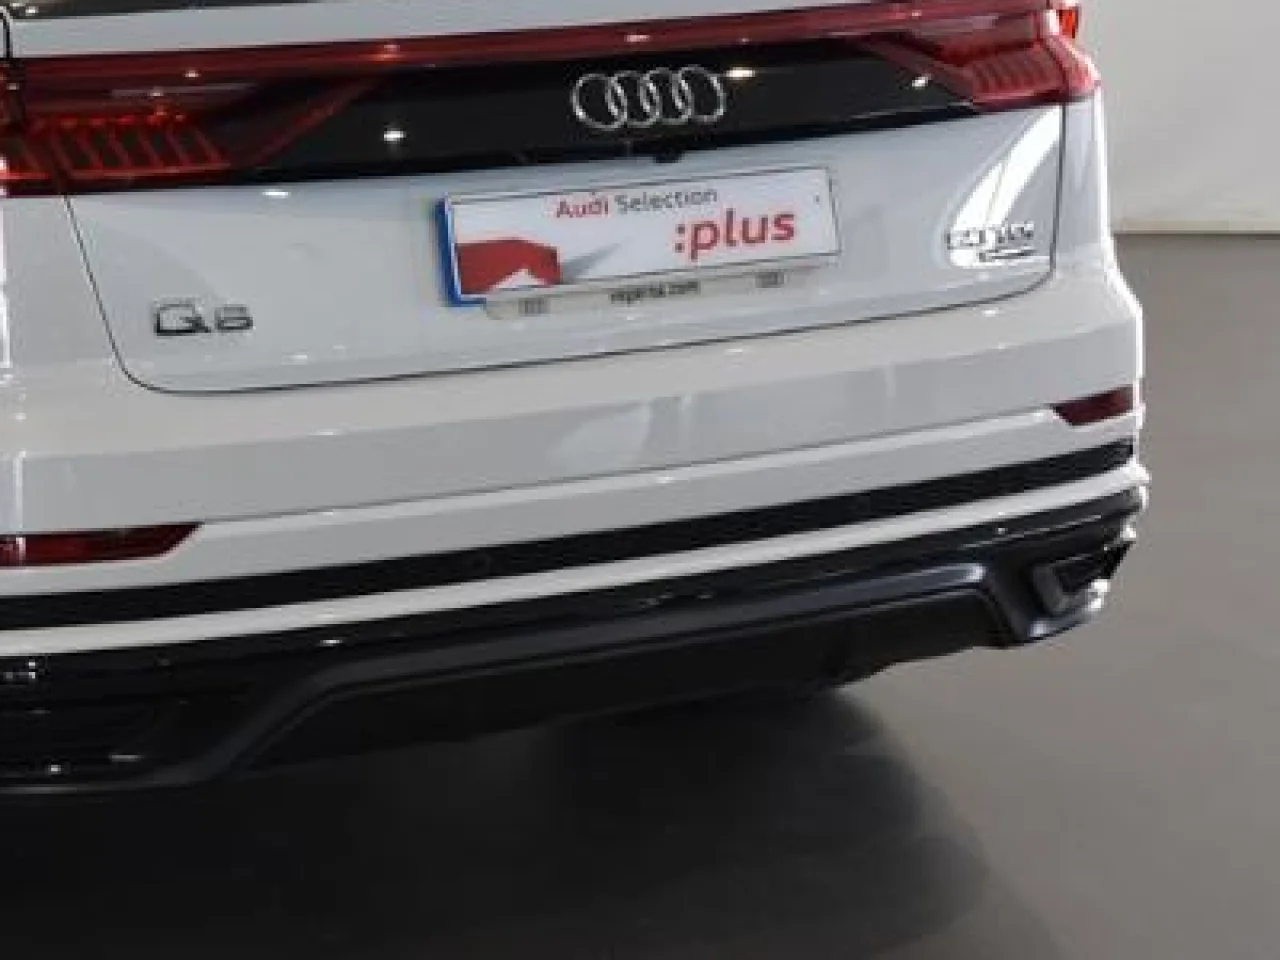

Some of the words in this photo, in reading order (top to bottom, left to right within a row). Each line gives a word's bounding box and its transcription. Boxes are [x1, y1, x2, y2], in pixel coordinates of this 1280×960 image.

[556, 193, 610, 218] Audi
[614, 187, 718, 214] Selection
[673, 207, 797, 260] :plus
